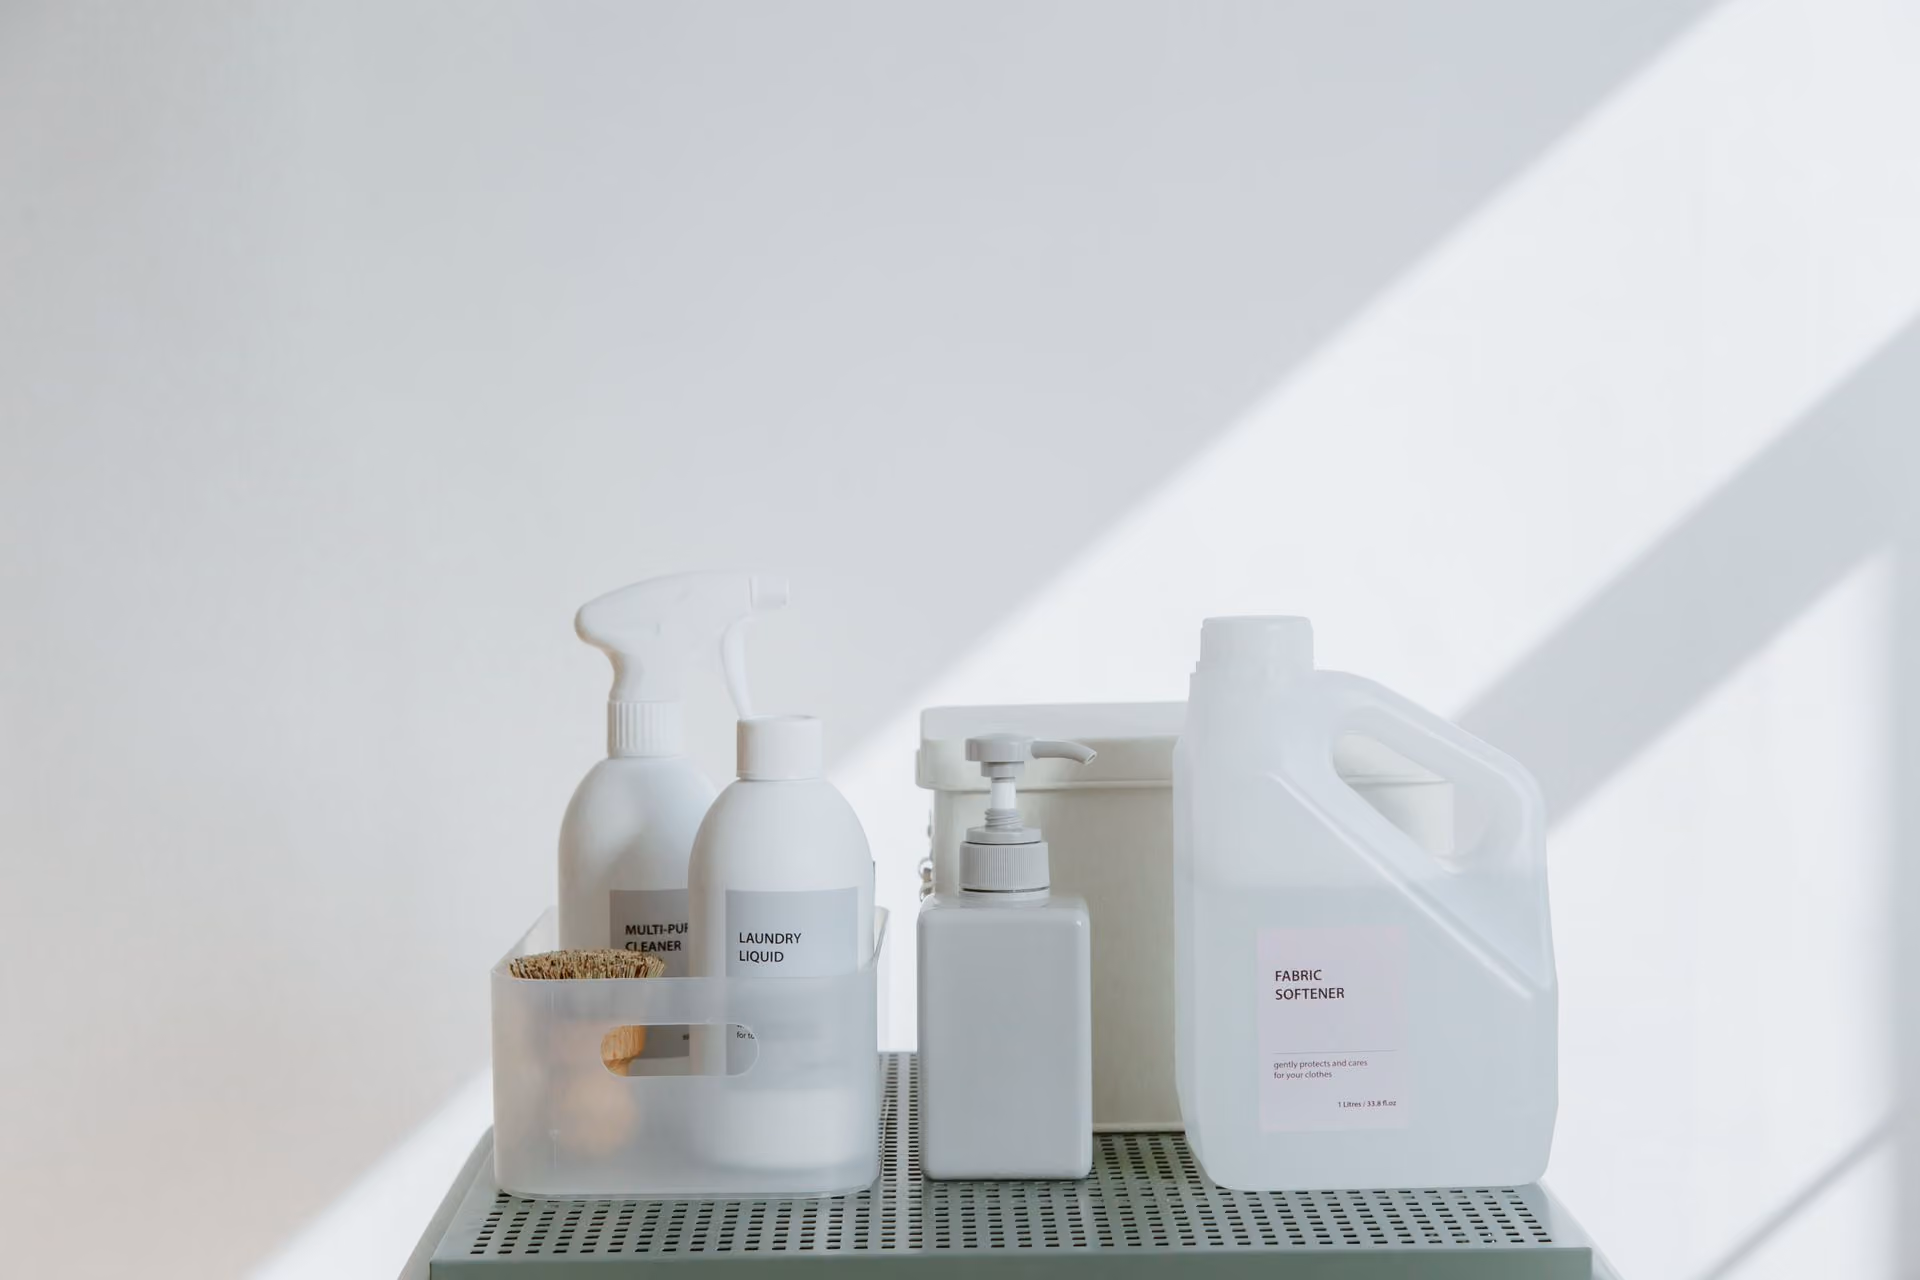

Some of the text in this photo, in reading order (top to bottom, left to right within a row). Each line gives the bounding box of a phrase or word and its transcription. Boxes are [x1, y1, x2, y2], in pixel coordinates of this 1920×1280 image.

[739, 932, 802, 944] LAUNDRY
[625, 940, 682, 952] CLEANER
[739, 950, 784, 963] LIQUID
[1275, 969, 1322, 982] FABRIC
[1275, 987, 1345, 1000] SOFTENER
[736, 1031, 746, 1039] for
[1273, 1059, 1368, 1070] gently protects and cares
[1273, 1070, 1333, 1080] for your clothes
